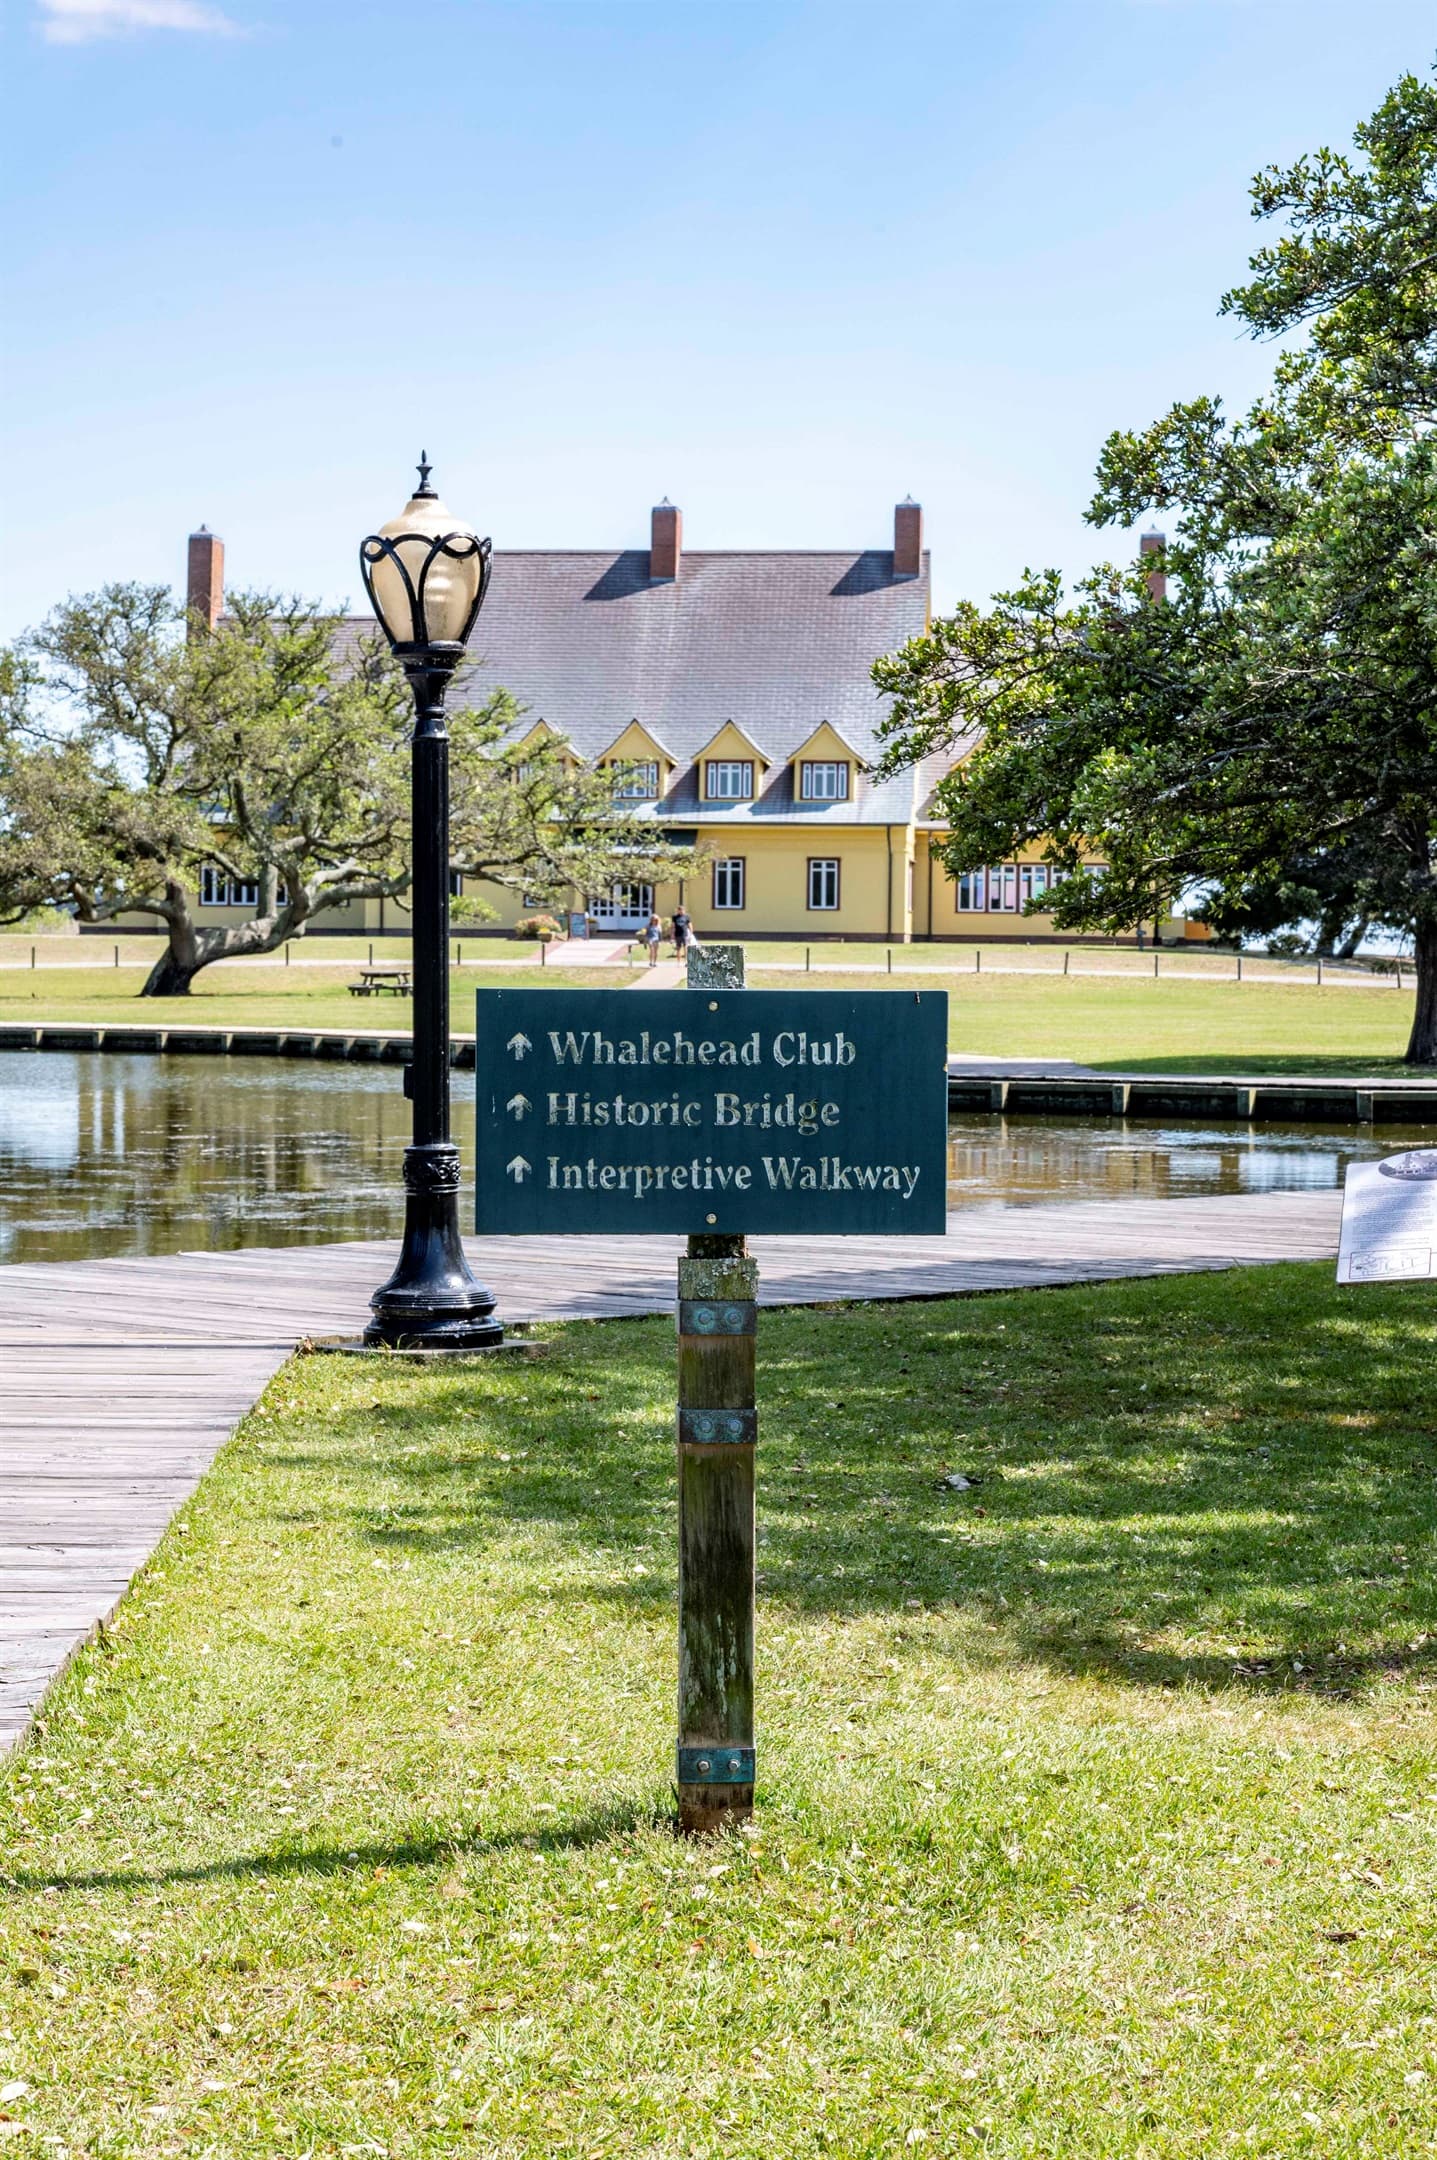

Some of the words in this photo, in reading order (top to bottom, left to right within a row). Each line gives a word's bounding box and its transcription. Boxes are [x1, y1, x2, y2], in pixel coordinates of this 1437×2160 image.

[548, 1032, 761, 1065] Whalehead
[773, 1032, 856, 1067] Club
[547, 1093, 702, 1126] Historic
[714, 1093, 840, 1135] Bridge
[547, 1157, 752, 1198] Interpretive
[762, 1157, 920, 1199] Walkway
